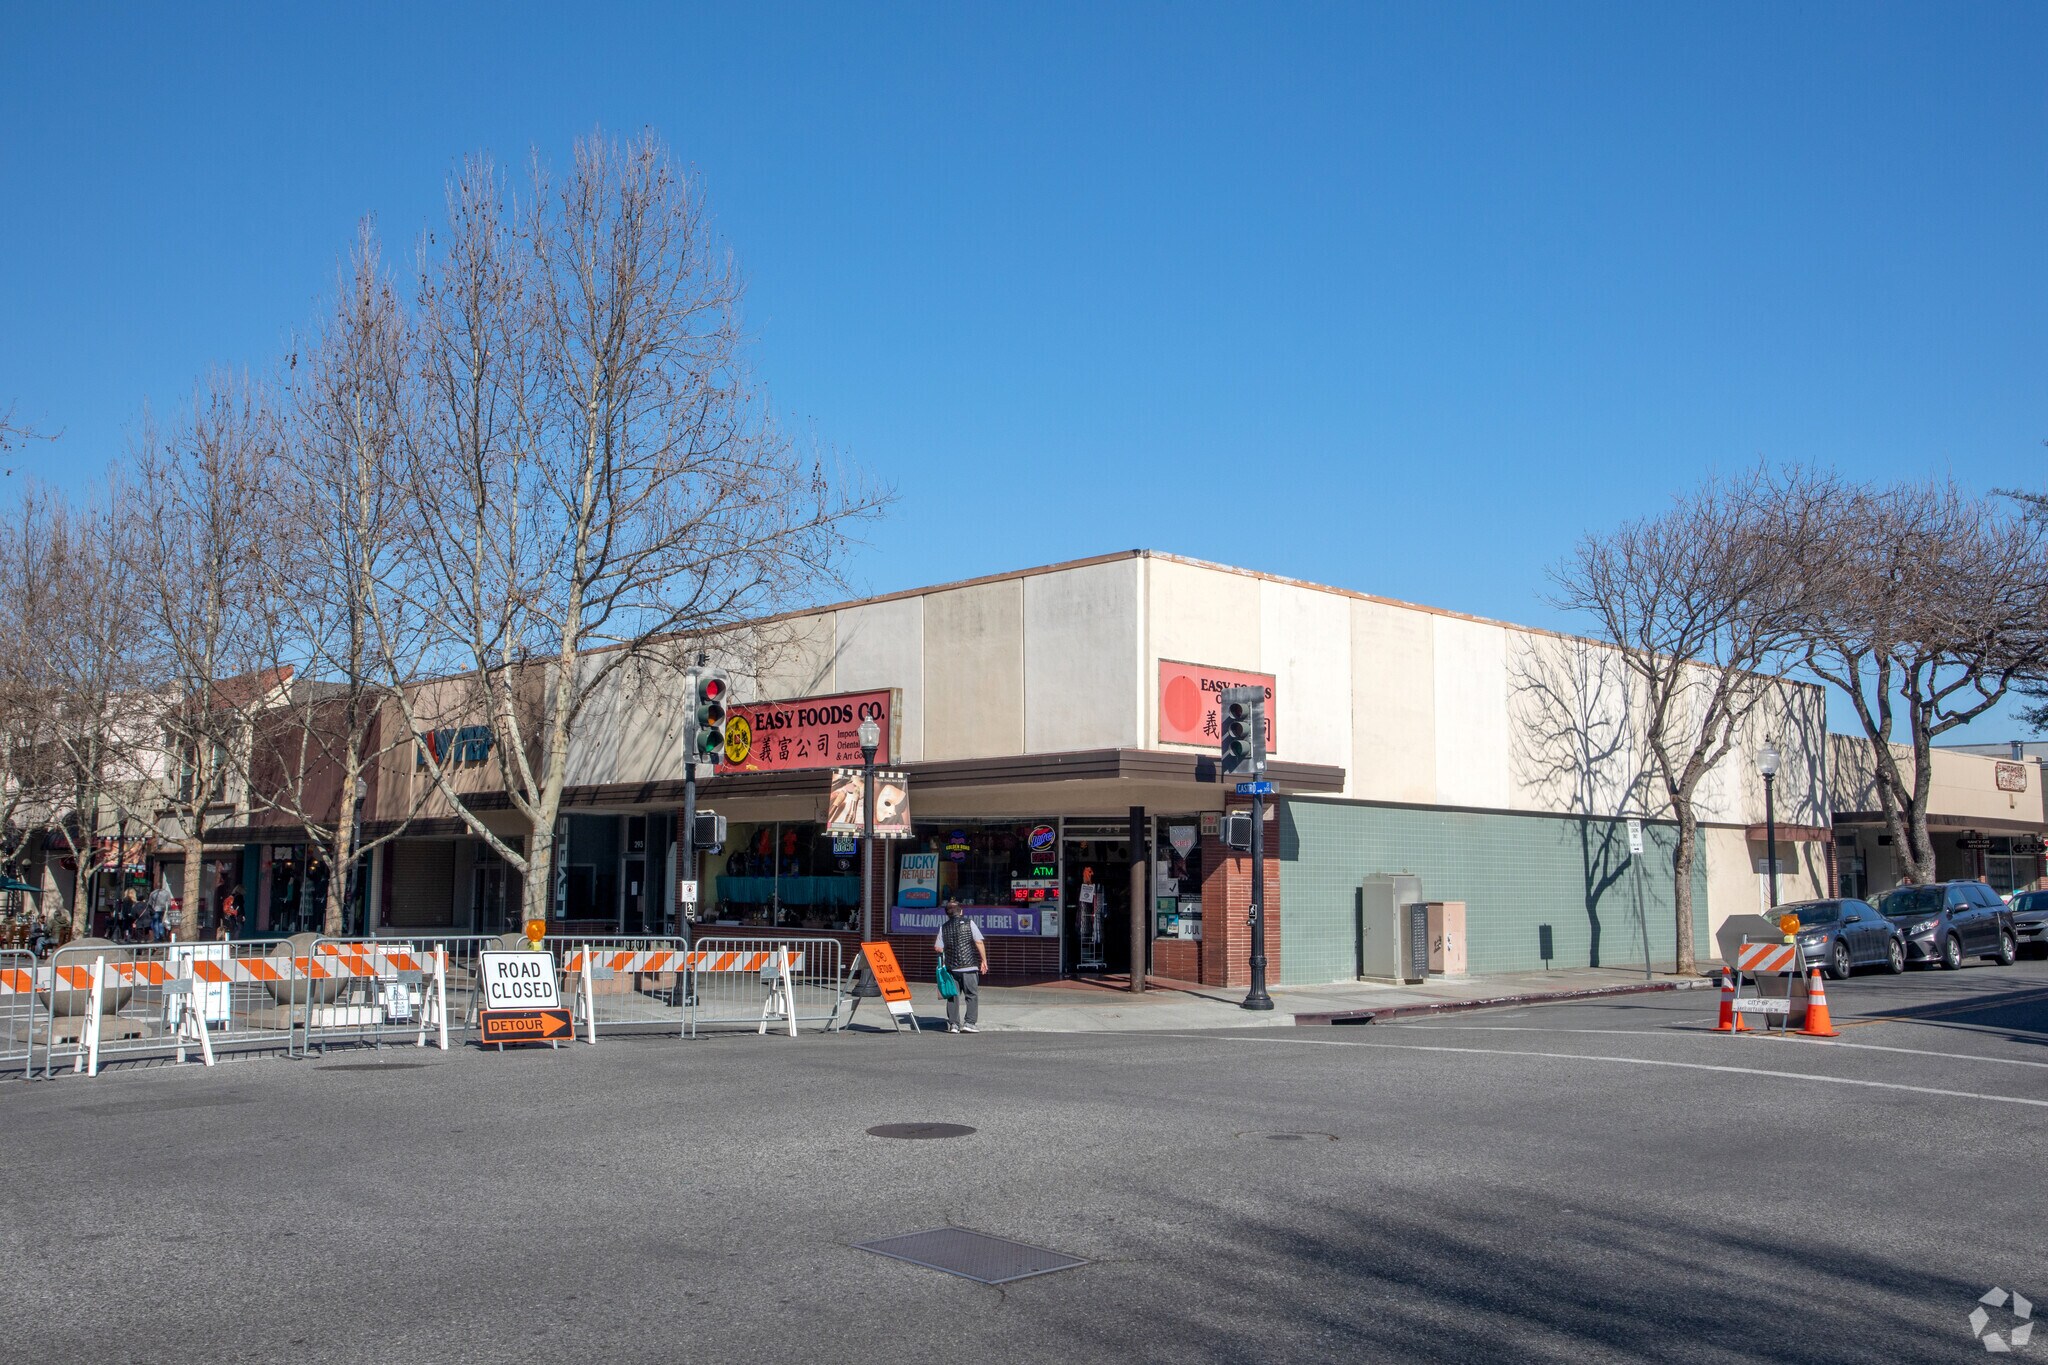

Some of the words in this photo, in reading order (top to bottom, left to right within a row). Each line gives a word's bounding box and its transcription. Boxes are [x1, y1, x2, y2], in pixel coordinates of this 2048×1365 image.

[1201, 679, 1230, 692] EASY
[755, 710, 794, 731] EASY
[798, 704, 853, 728] FOODS
[858, 701, 885, 721] CO.
[837, 730, 859, 739] Importe
[843, 752, 853, 760] Art
[1237, 784, 1256, 794] CASTRO
[903, 855, 936, 869] LUCKY
[901, 869, 935, 880] RETAILER
[1033, 866, 1054, 876] ATM
[987, 915, 1012, 929] HERE!
[498, 962, 541, 978] ROAD
[876, 964, 894, 974] DETOUR
[492, 982, 552, 998] CLOSED
[490, 1019, 544, 1032] DETOUR
